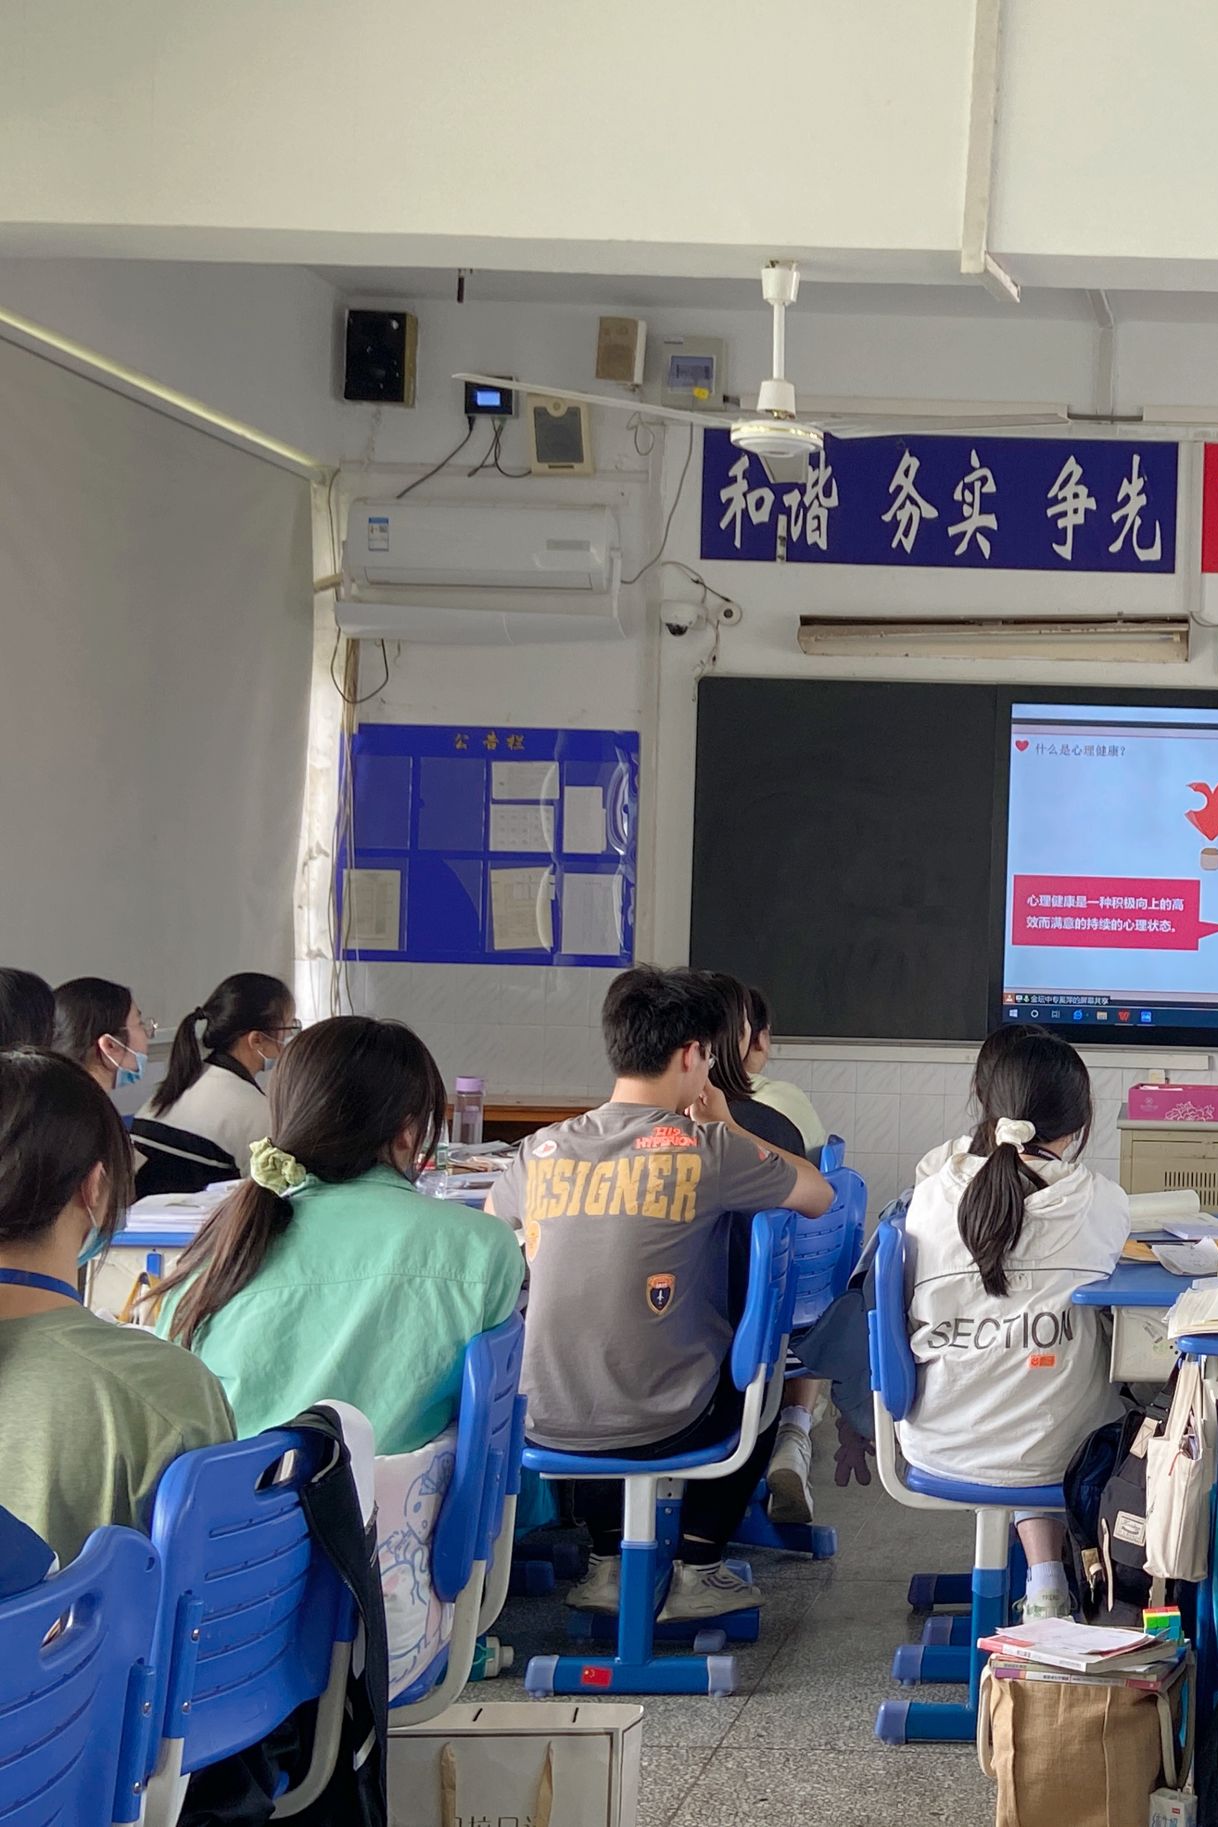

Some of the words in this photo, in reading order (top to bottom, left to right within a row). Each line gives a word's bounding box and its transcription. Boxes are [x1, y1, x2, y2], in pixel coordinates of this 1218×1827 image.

[720, 451, 839, 551] 和谐
[881, 448, 999, 560] 务实
[1046, 454, 1162, 562] 争先
[1035, 743, 1126, 757] 什么是心理健康？
[1026, 894, 1185, 912] 心理健康是一种积极向上的高
[1026, 916, 1177, 933] 效而满意的持续的心理状态。
[526, 1153, 702, 1224] DESIGNER
[928, 1308, 1074, 1350] SECTION
